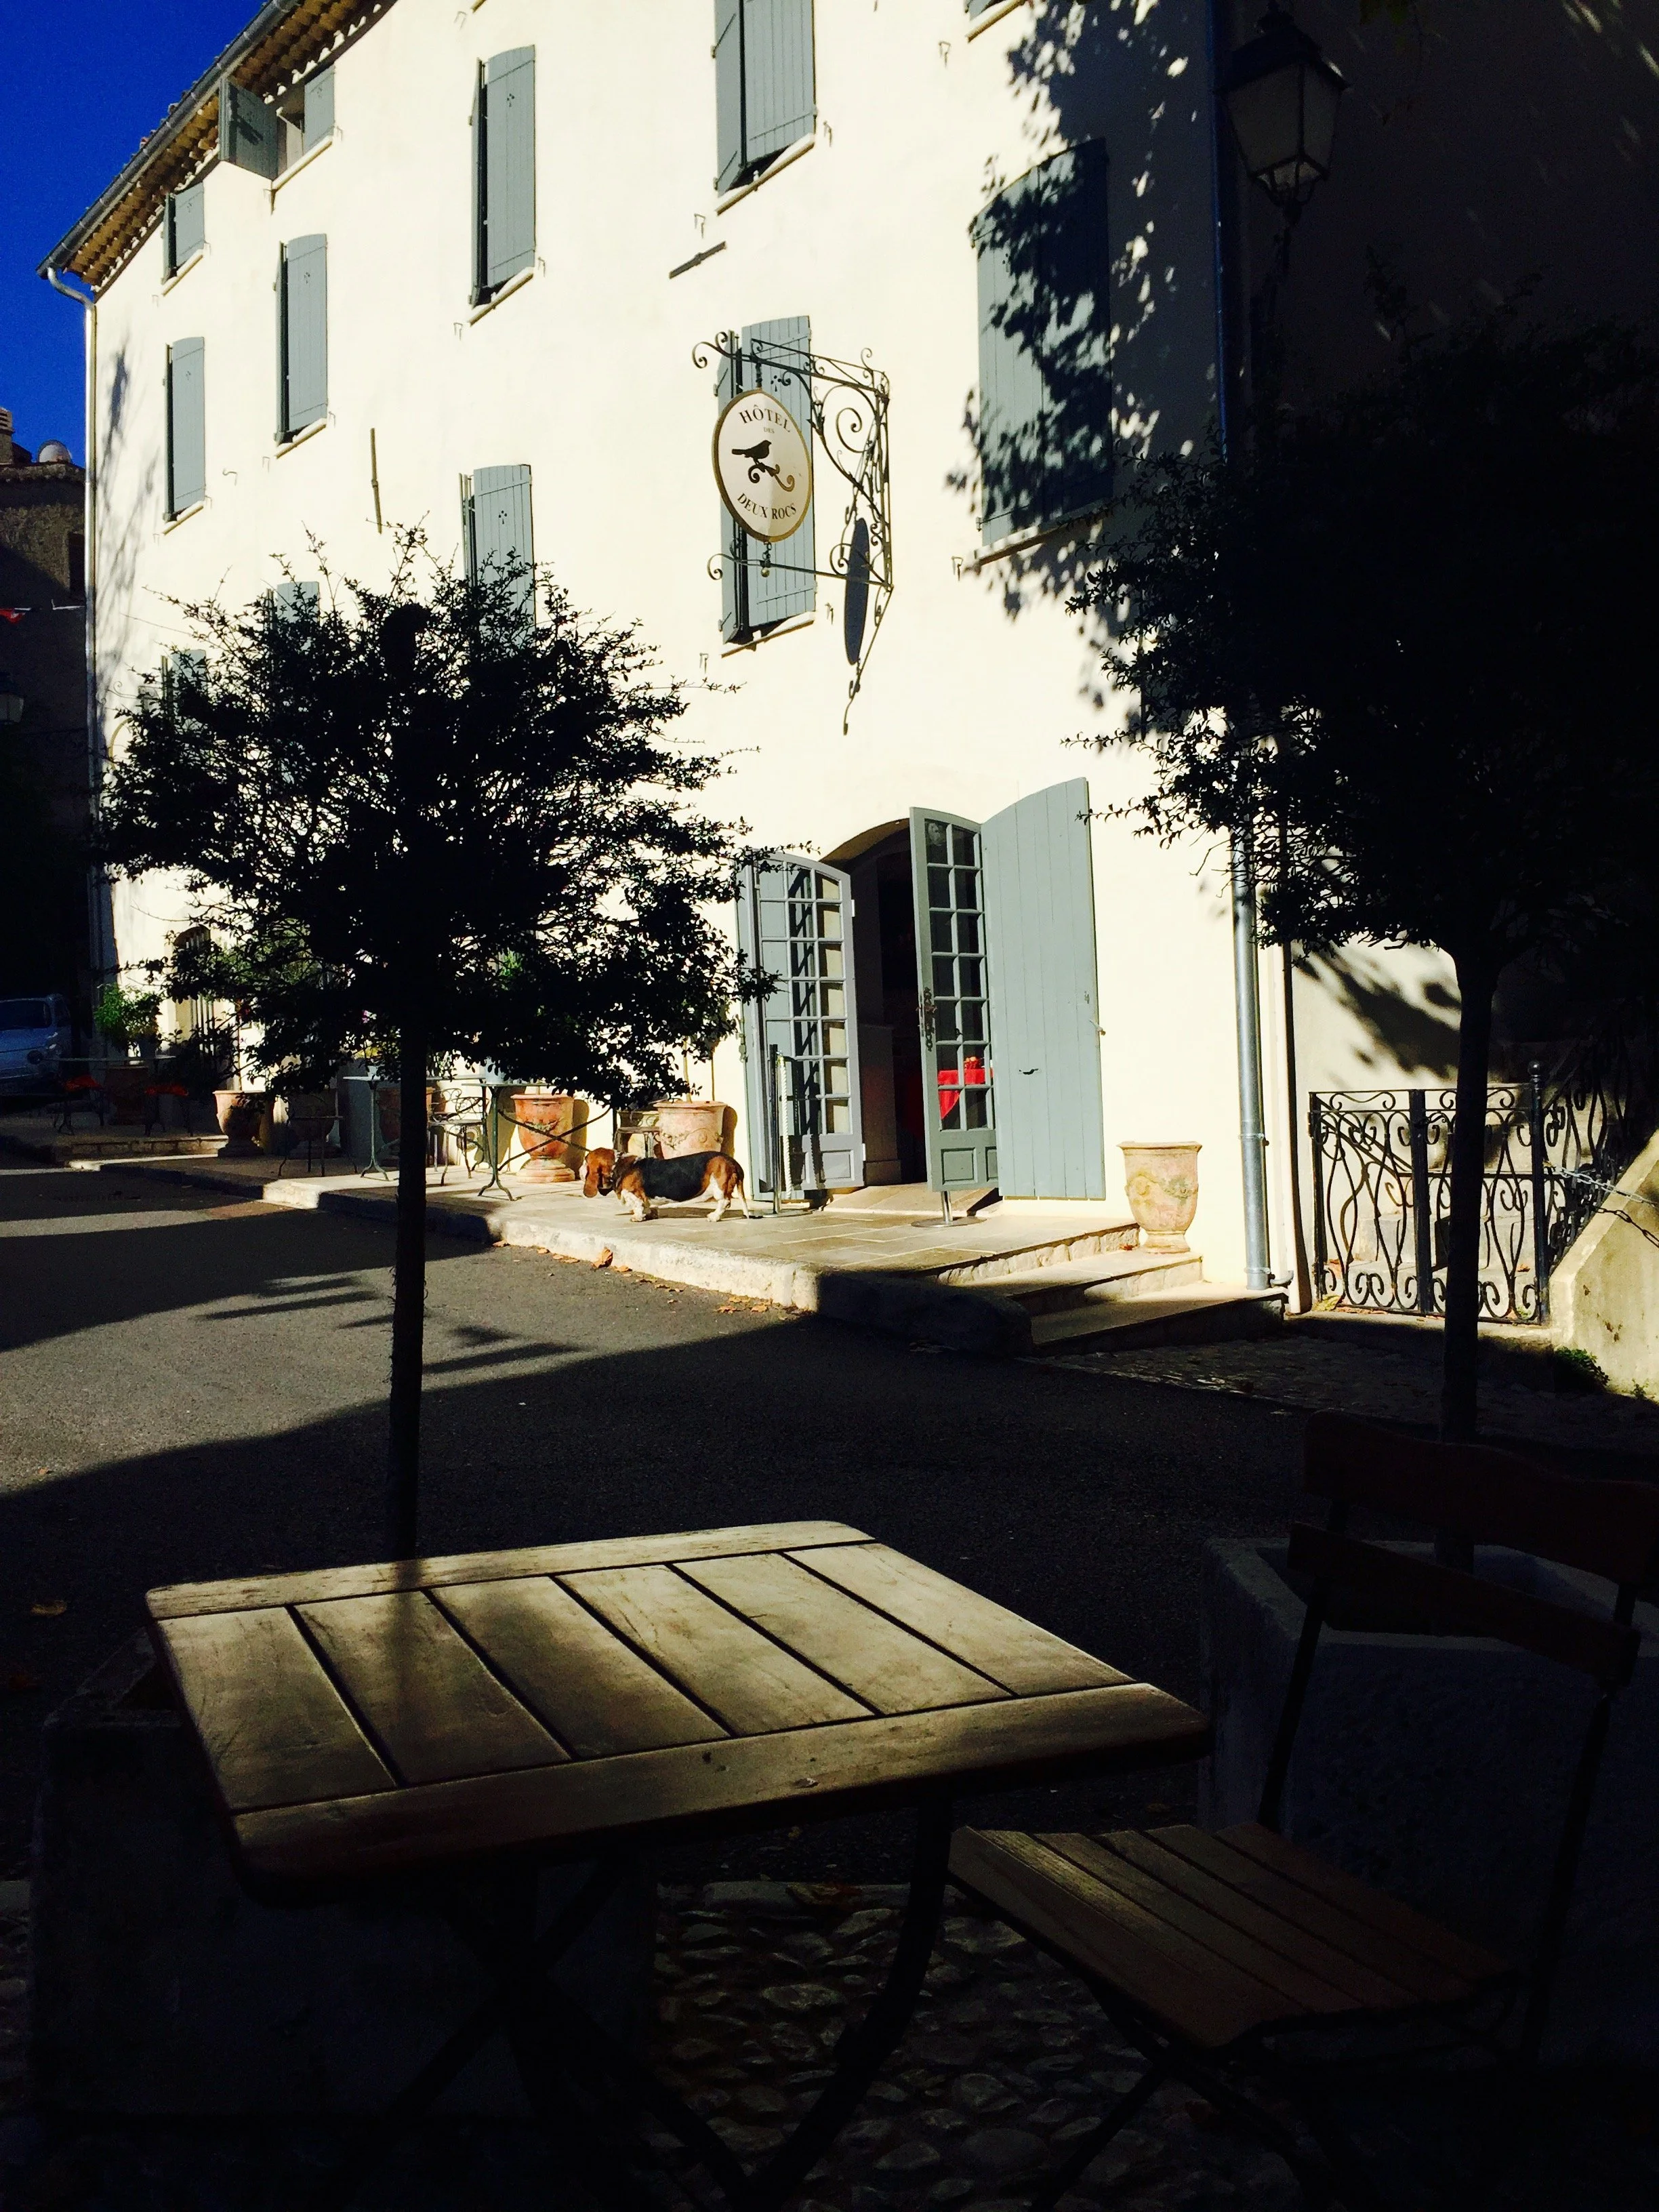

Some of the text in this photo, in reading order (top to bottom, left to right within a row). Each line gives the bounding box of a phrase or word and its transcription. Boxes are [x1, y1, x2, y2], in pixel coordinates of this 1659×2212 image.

[739, 405, 790, 432] HÔTEL
[737, 493, 796, 520] DEUX ROCS
